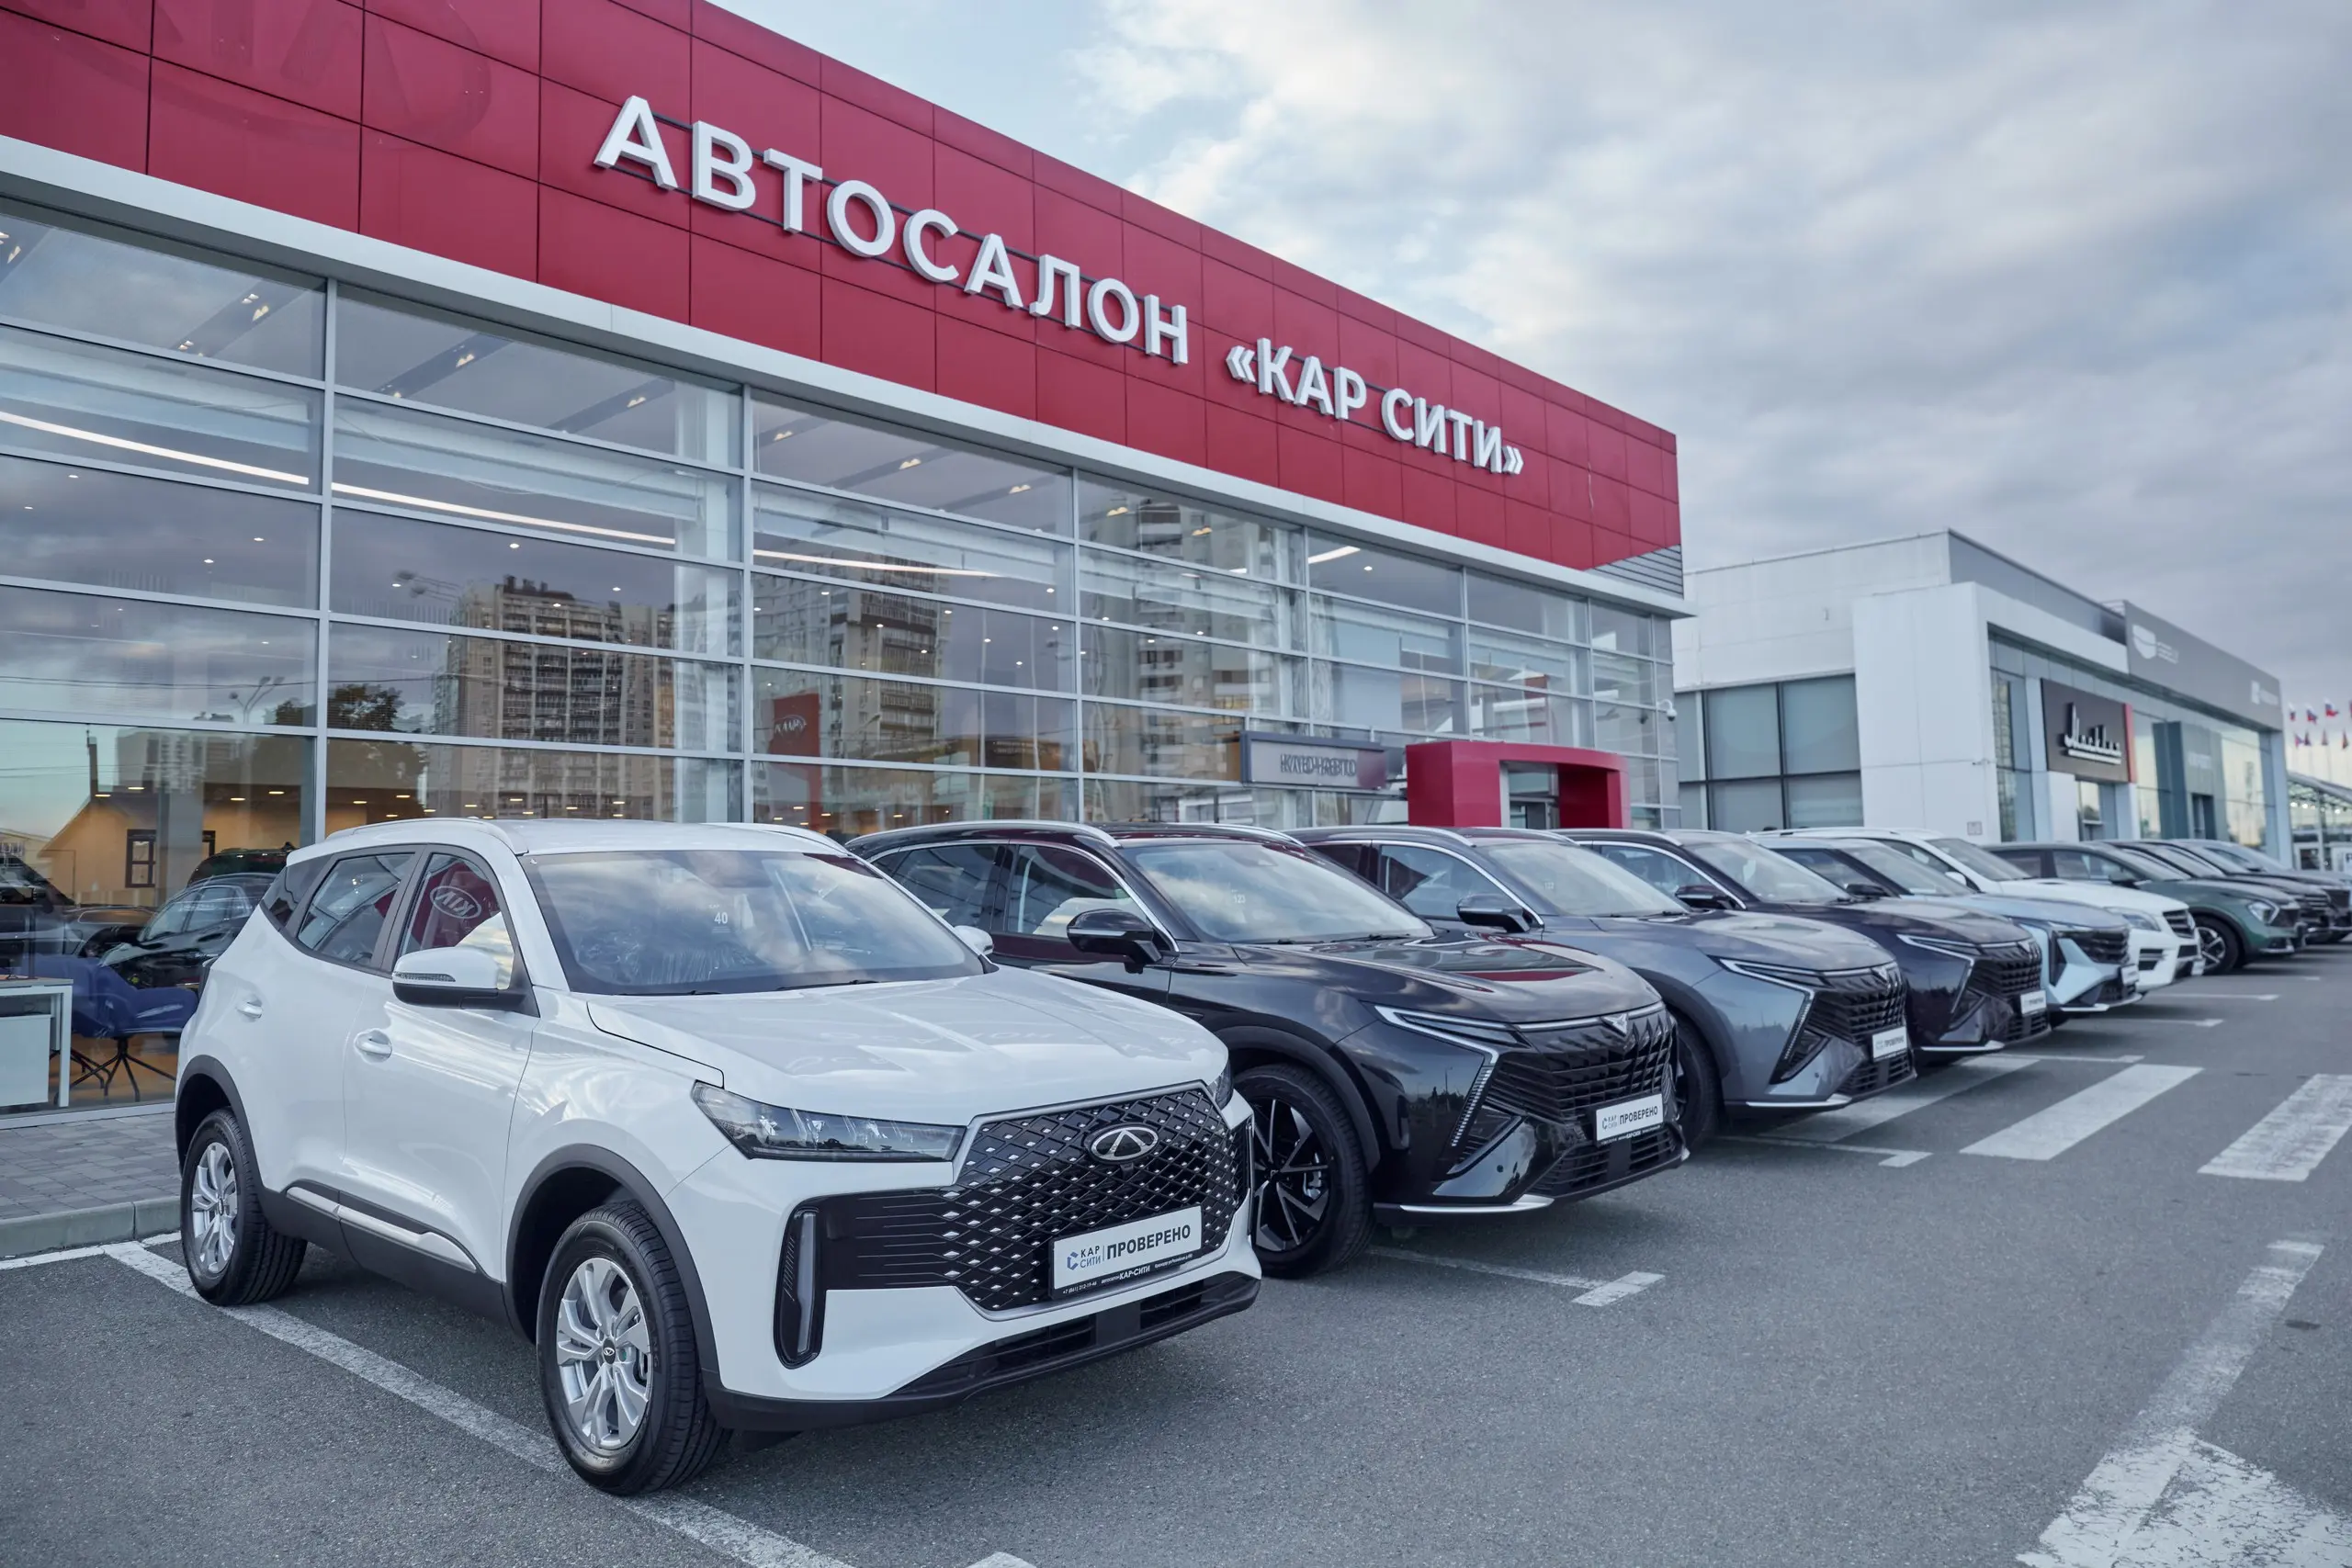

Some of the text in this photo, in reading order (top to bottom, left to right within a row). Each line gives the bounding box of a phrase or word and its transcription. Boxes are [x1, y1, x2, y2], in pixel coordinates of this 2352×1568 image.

[594, 95, 1525, 475] АВТОСАЛОН «КАР СИТИ»
[714, 912, 729, 924] 40
[1619, 1105, 1658, 1125] ПРОВЕРЕНО
[1106, 1224, 1192, 1260] ПРОВЕРЕНО
[1080, 1245, 1101, 1258] КАР
[1079, 1257, 1102, 1269] СИТИ
